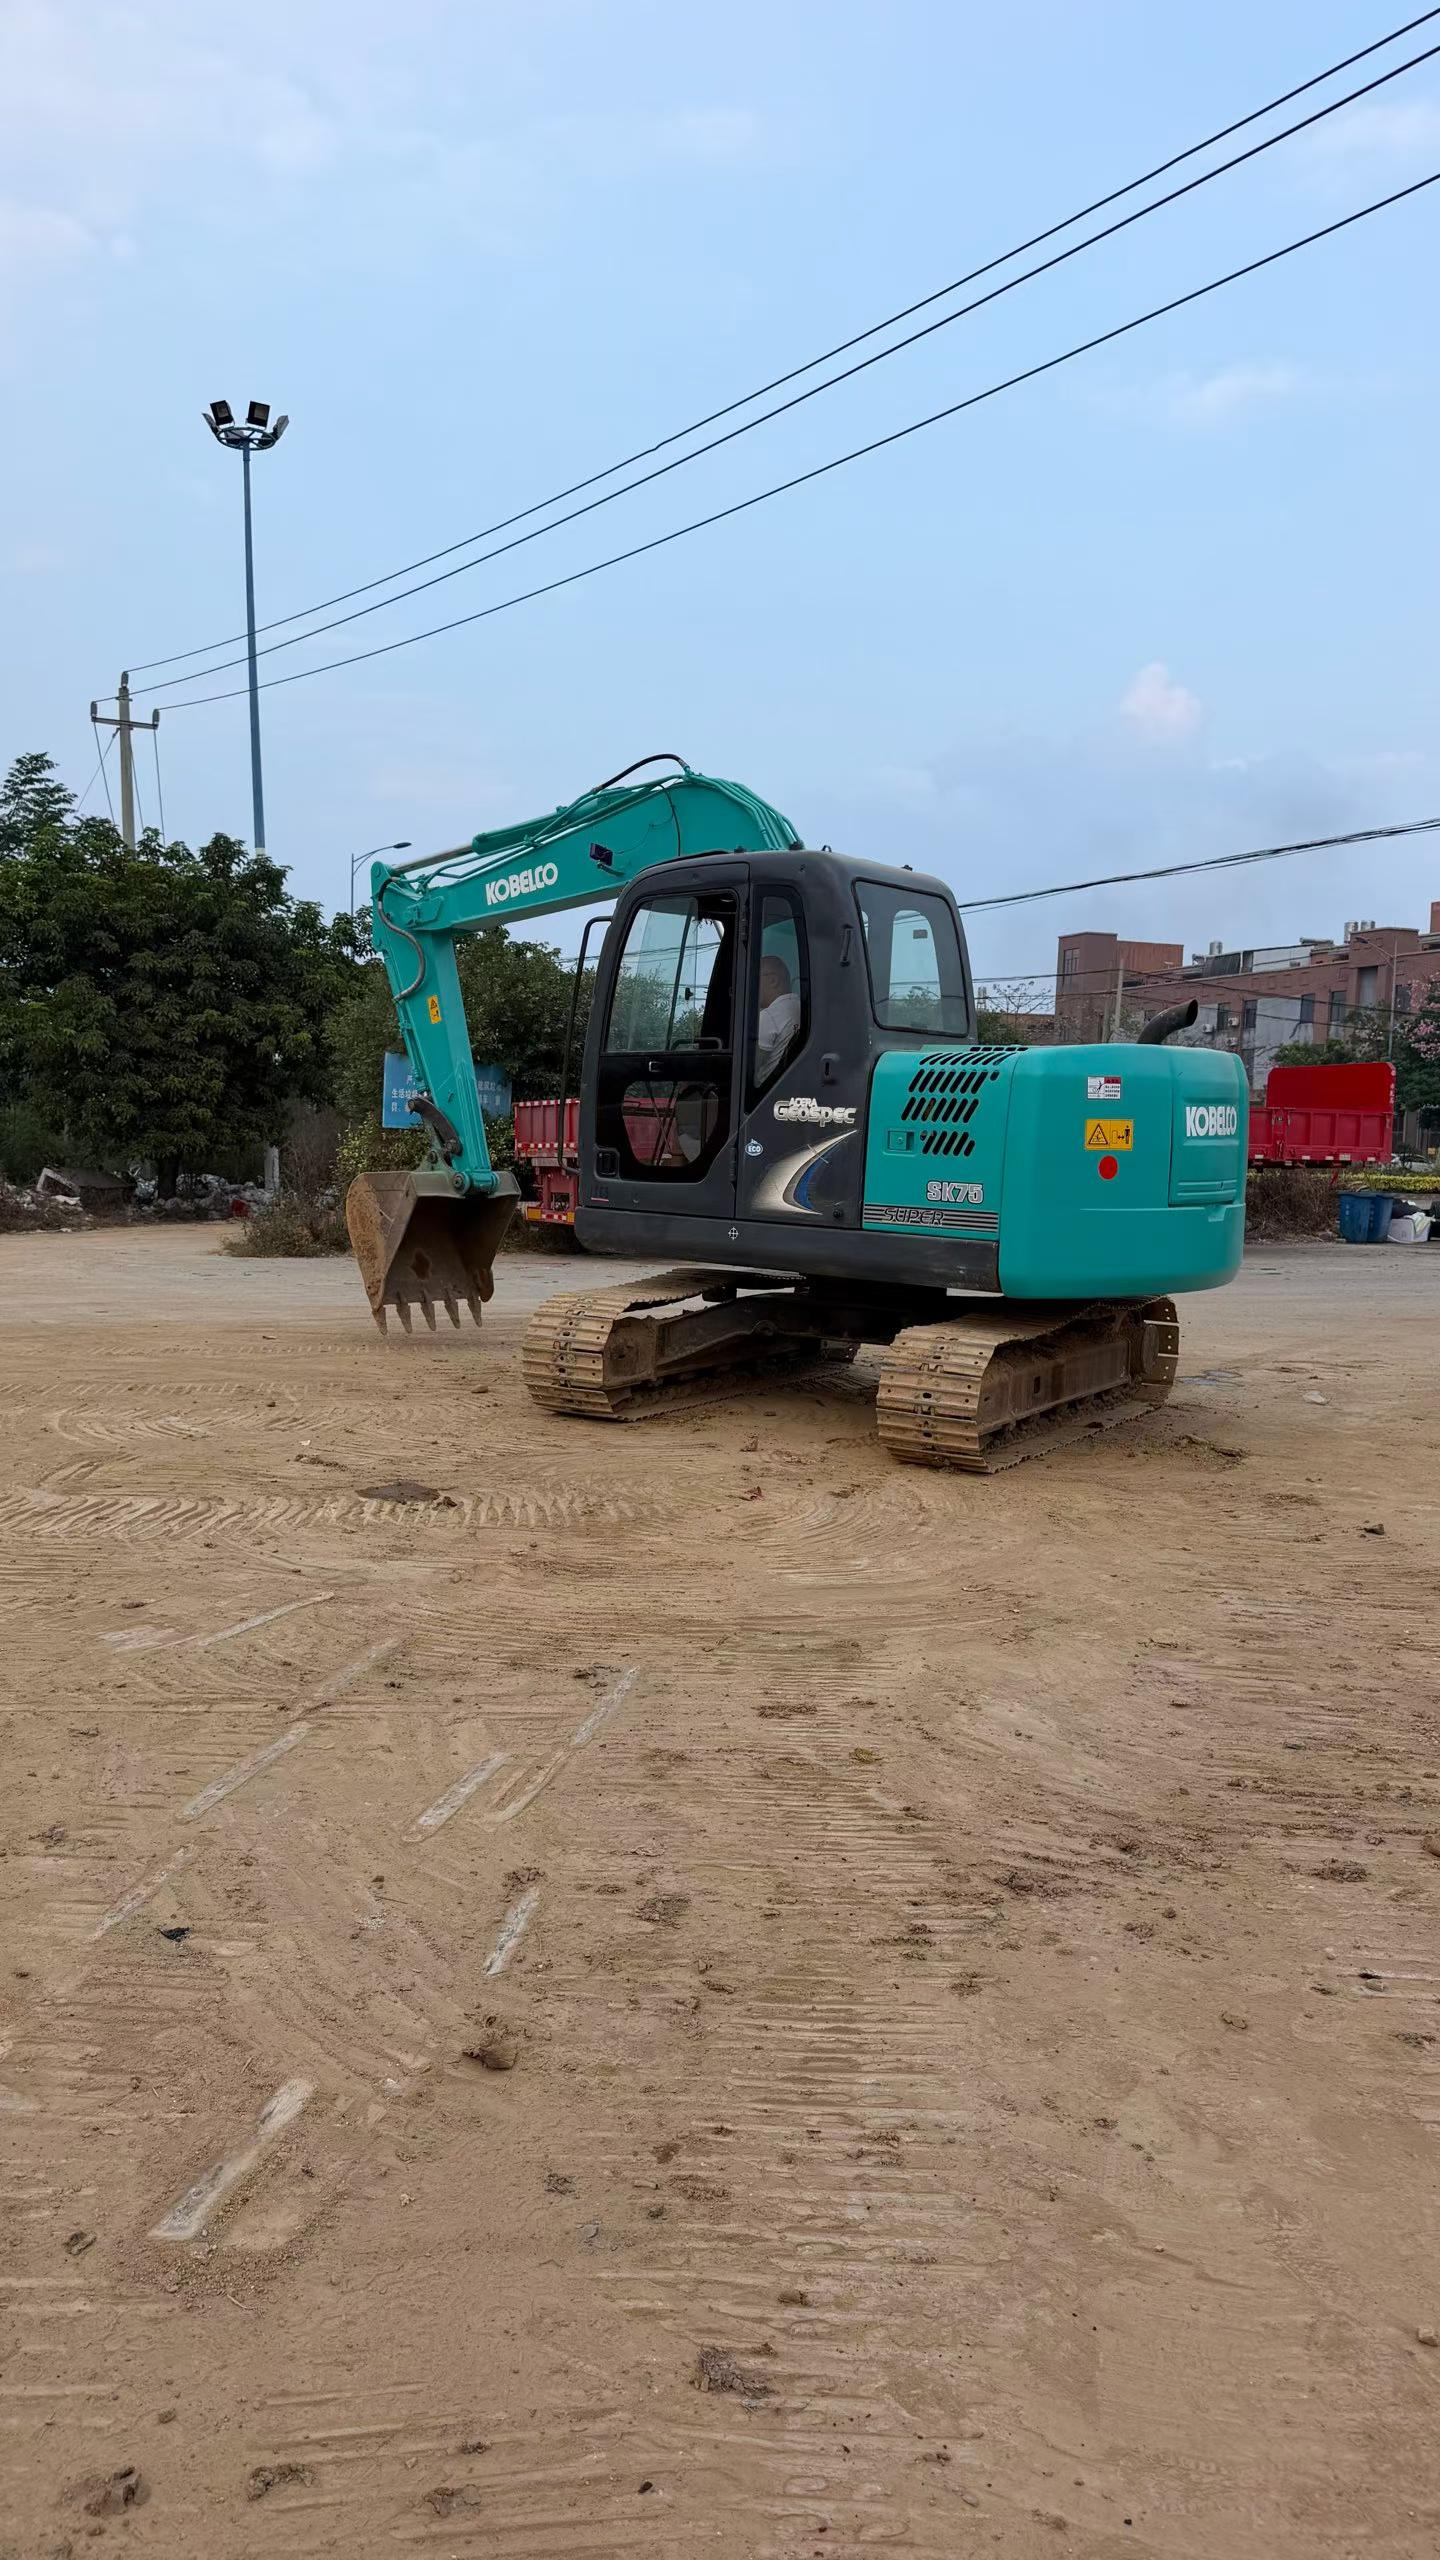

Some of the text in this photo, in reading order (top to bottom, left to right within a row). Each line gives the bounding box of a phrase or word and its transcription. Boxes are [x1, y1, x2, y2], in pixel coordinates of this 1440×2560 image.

[485, 862, 558, 906] KOBELCO
[789, 1097, 818, 1109] ACERA
[1185, 1106, 1237, 1137] KOBELCO
[748, 1145, 761, 1153] ECO
[926, 1181, 983, 1204] SK75
[883, 1207, 944, 1227] SUPER
